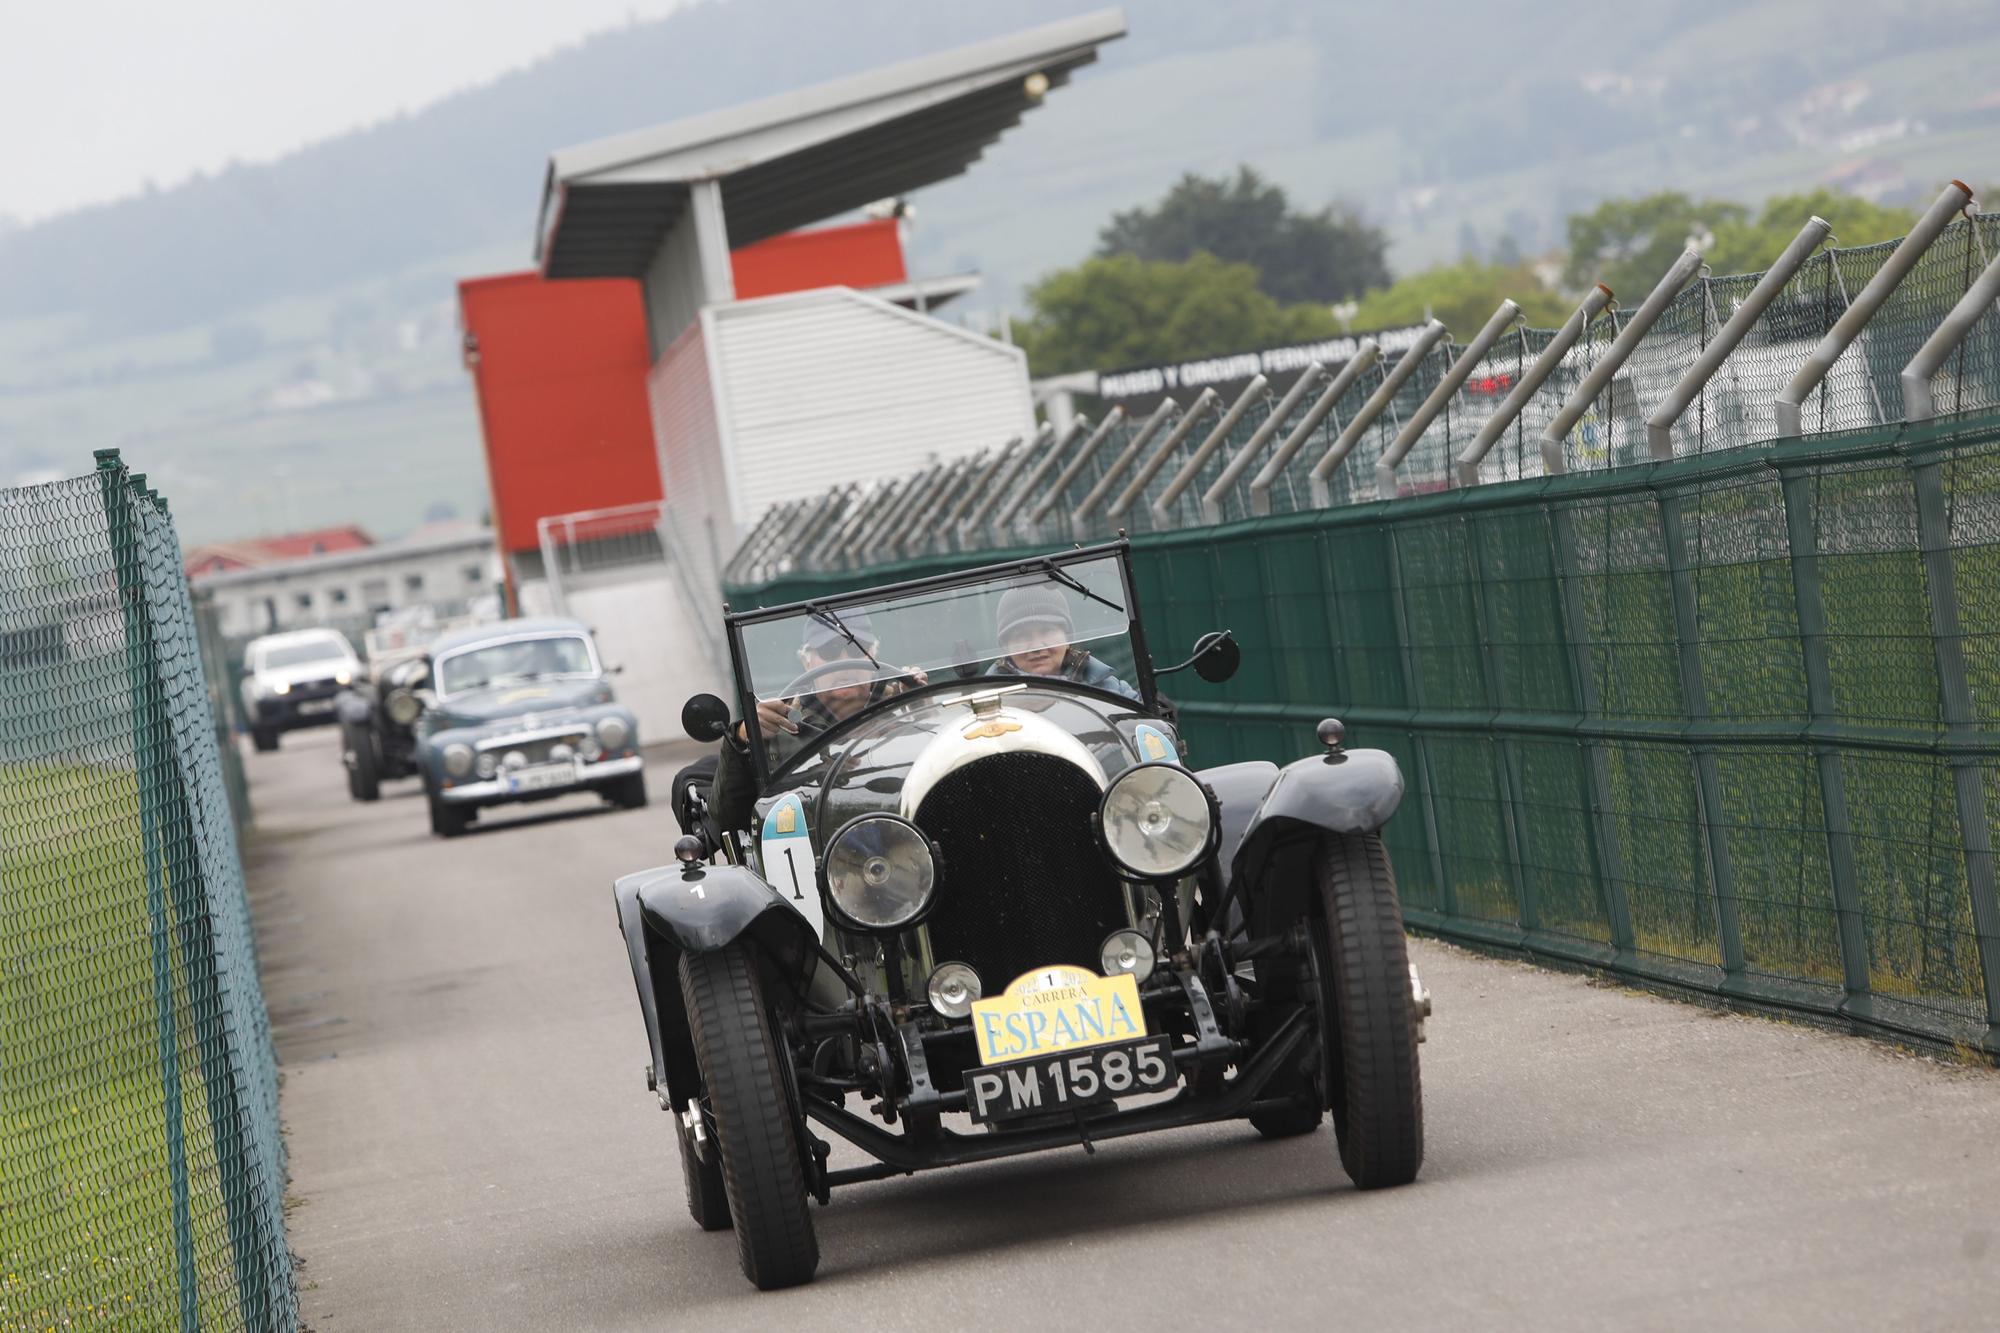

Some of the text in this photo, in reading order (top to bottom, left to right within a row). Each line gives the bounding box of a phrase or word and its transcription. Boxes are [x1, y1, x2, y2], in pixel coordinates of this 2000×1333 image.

[784, 847, 804, 900] 1
[690, 884, 705, 899] 1
[1047, 973, 1054, 987] 1
[1022, 985, 1089, 1007] CARRERA
